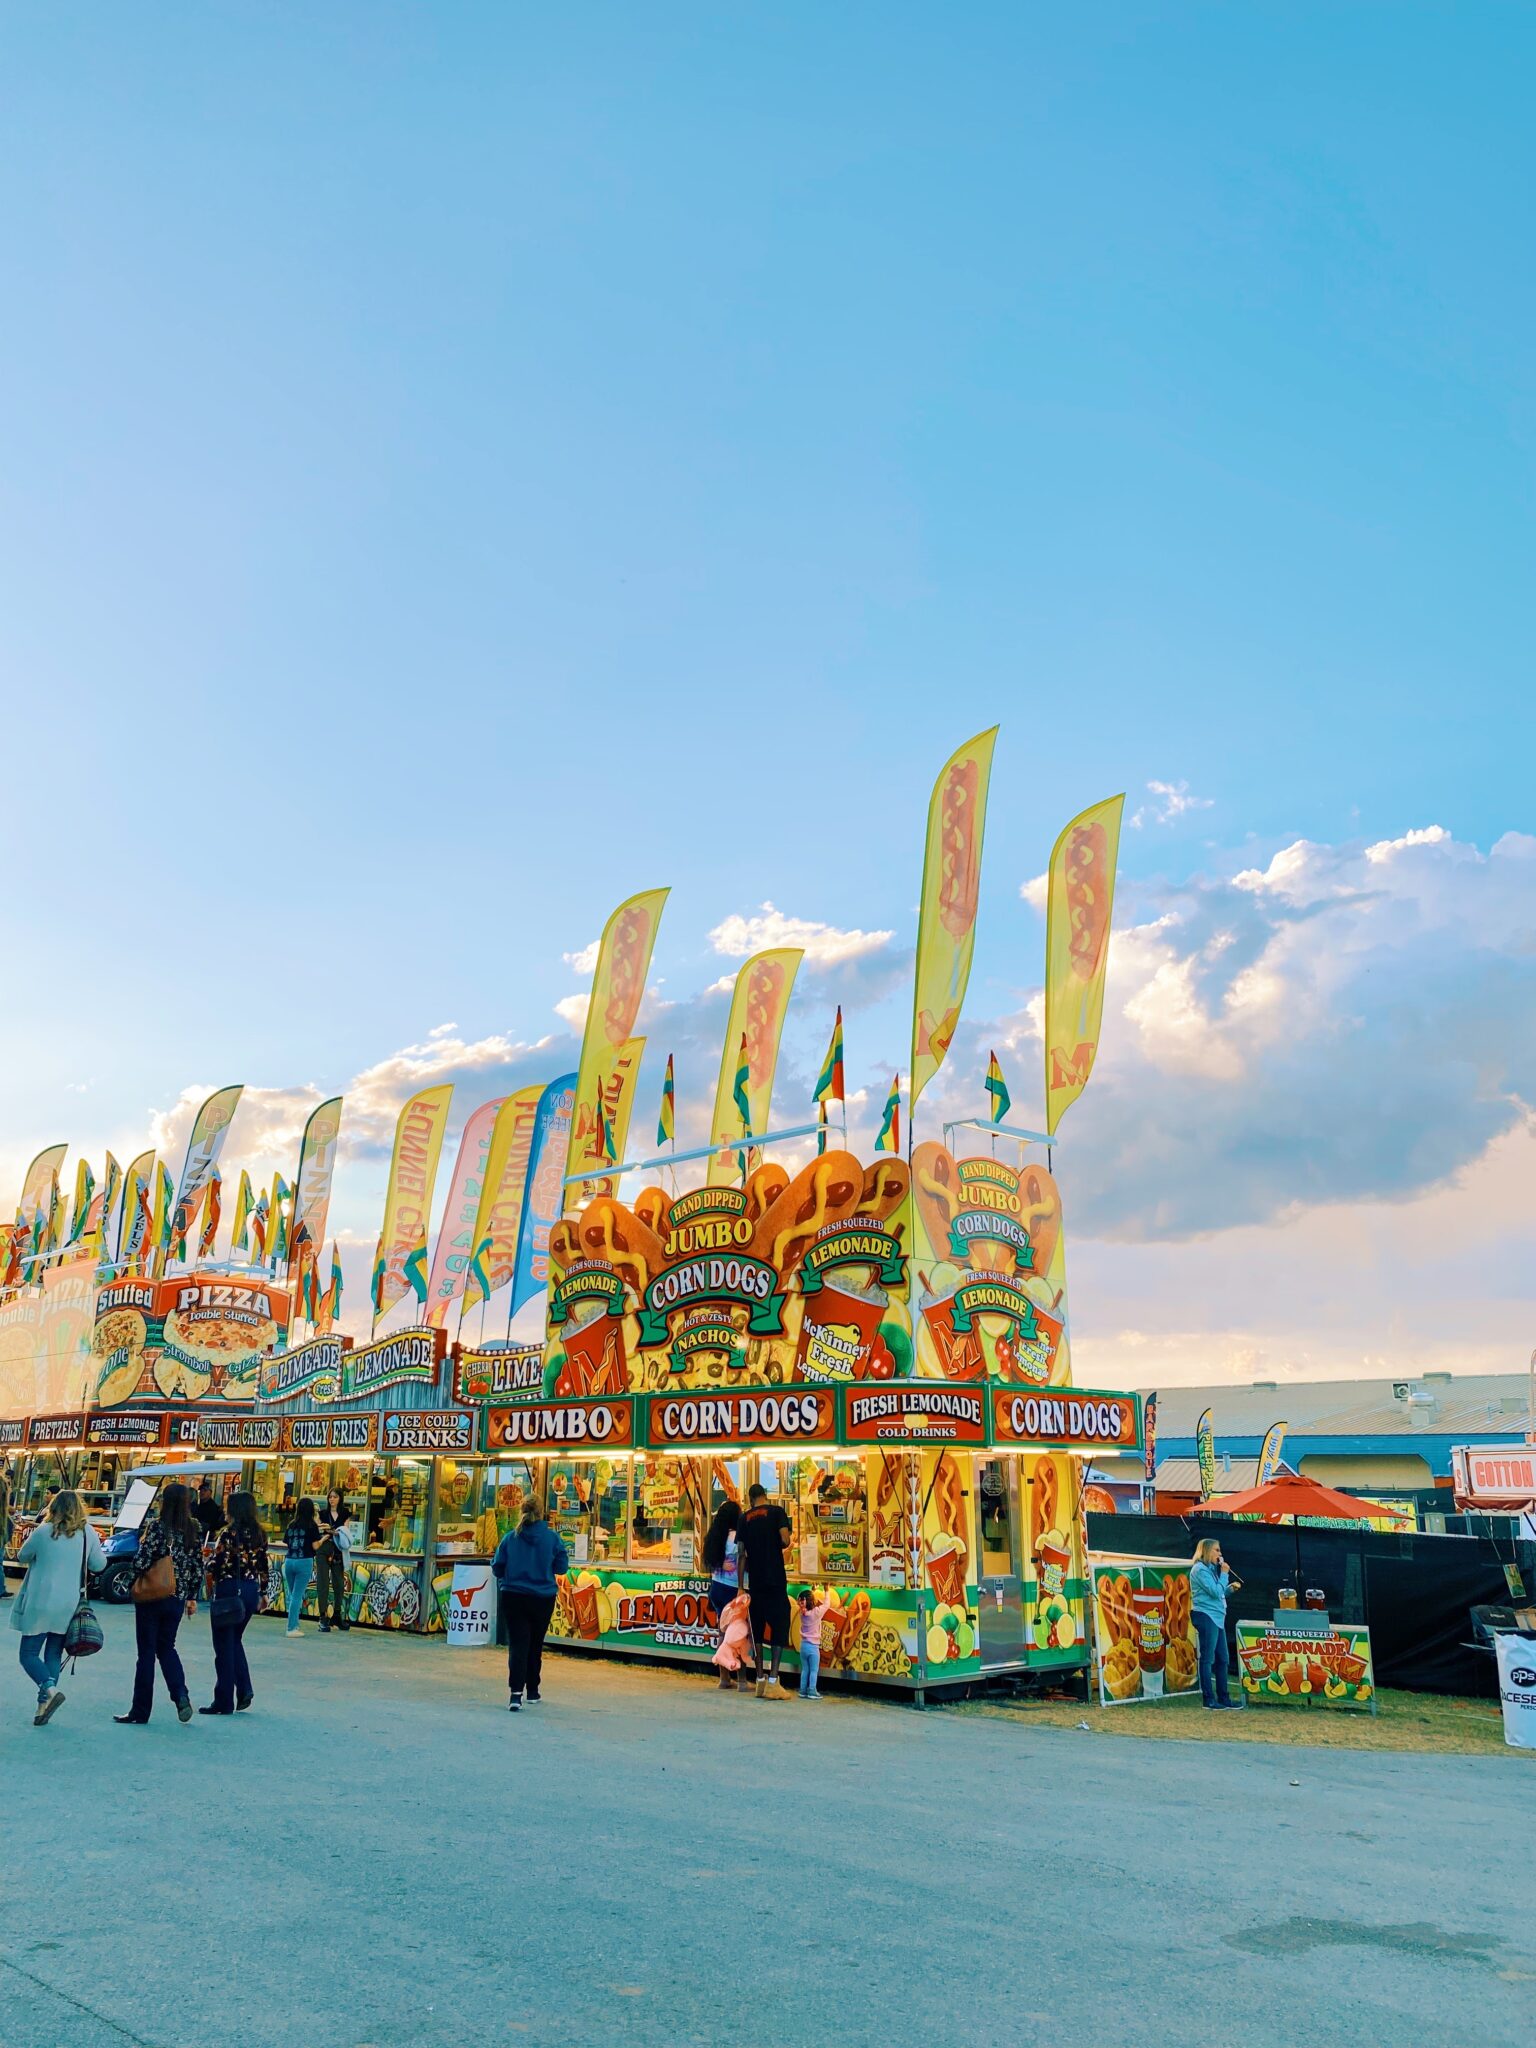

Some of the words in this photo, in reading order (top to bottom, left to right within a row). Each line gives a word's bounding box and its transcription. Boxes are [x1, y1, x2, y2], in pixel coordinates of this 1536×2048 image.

[296, 1119, 336, 1244] PIZZA
[961, 1164, 985, 1179] HAND
[985, 1166, 1016, 1190] DIPPED
[673, 1197, 702, 1222] HAND
[703, 1192, 743, 1210] DIPPED
[957, 1187, 1021, 1213] JUMBO
[664, 1217, 753, 1256] JUMBO
[817, 1220, 842, 1240] FRESH
[842, 1217, 884, 1231] SQUEEZED
[956, 1215, 991, 1236] CORN
[992, 1217, 1027, 1247] DOGS
[810, 1236, 893, 1269] LEMONADE
[565, 1262, 584, 1277] FRESH
[583, 1259, 613, 1271] SQUEEZED
[966, 1270, 988, 1285] FRESH
[987, 1271, 1022, 1291] SQUEEZED
[559, 1275, 618, 1301] LEMONADE
[651, 1262, 707, 1309] CORN
[709, 1260, 770, 1298] DOGS
[97, 1283, 153, 1313] Stuffed
[179, 1285, 272, 1318] PIZZA
[961, 1290, 1028, 1316] LEMONADE
[189, 1310, 221, 1322] Double
[223, 1311, 259, 1326] Stuffed
[684, 1315, 700, 1329] HOT
[700, 1315, 707, 1324] &
[708, 1313, 733, 1324] ZESTY
[677, 1329, 742, 1353] NACHOS
[1021, 1343, 1046, 1364] Fresh
[163, 1345, 210, 1372] Stromboli
[278, 1345, 339, 1389] LIMEADE
[355, 1337, 430, 1385] LEMONADE
[810, 1343, 852, 1376] Fresh
[493, 1354, 543, 1392] LIME
[397, 1415, 422, 1428] ICE
[424, 1414, 459, 1428] COLD
[663, 1400, 733, 1437] CORN
[738, 1396, 818, 1434] DOGS
[852, 1394, 899, 1425] FRESH
[901, 1393, 981, 1426] LEMONADE
[1010, 1397, 1066, 1435] CORN
[1068, 1400, 1121, 1438] DOGS
[34, 1419, 80, 1441] PRETZELS
[90, 1418, 116, 1432] FRESH
[118, 1417, 160, 1432] LEMONADE
[204, 1422, 240, 1448] FUNNEL
[241, 1420, 273, 1447] CAKES
[292, 1419, 330, 1448] CURLY
[331, 1418, 369, 1447] FRIES
[504, 1405, 614, 1441] JUMBO
[877, 1427, 909, 1438] COLD
[912, 1427, 957, 1438] DRINKS
[100, 1433, 118, 1442] COLD
[120, 1434, 146, 1442] DRINKS
[386, 1429, 469, 1448] DRINKS
[1204, 1434, 1214, 1492] PINEAPPLE
[1475, 1460, 1534, 1488] COTTON
[823, 1532, 858, 1545] LEMONADE
[825, 1561, 841, 1570] ICED
[842, 1562, 856, 1572] TEA
[654, 1580, 686, 1592] FRESH
[1265, 1629, 1292, 1637] FRESH
[1292, 1630, 1335, 1639] SQUEEZED
[1261, 1639, 1346, 1657] LEMONADE
